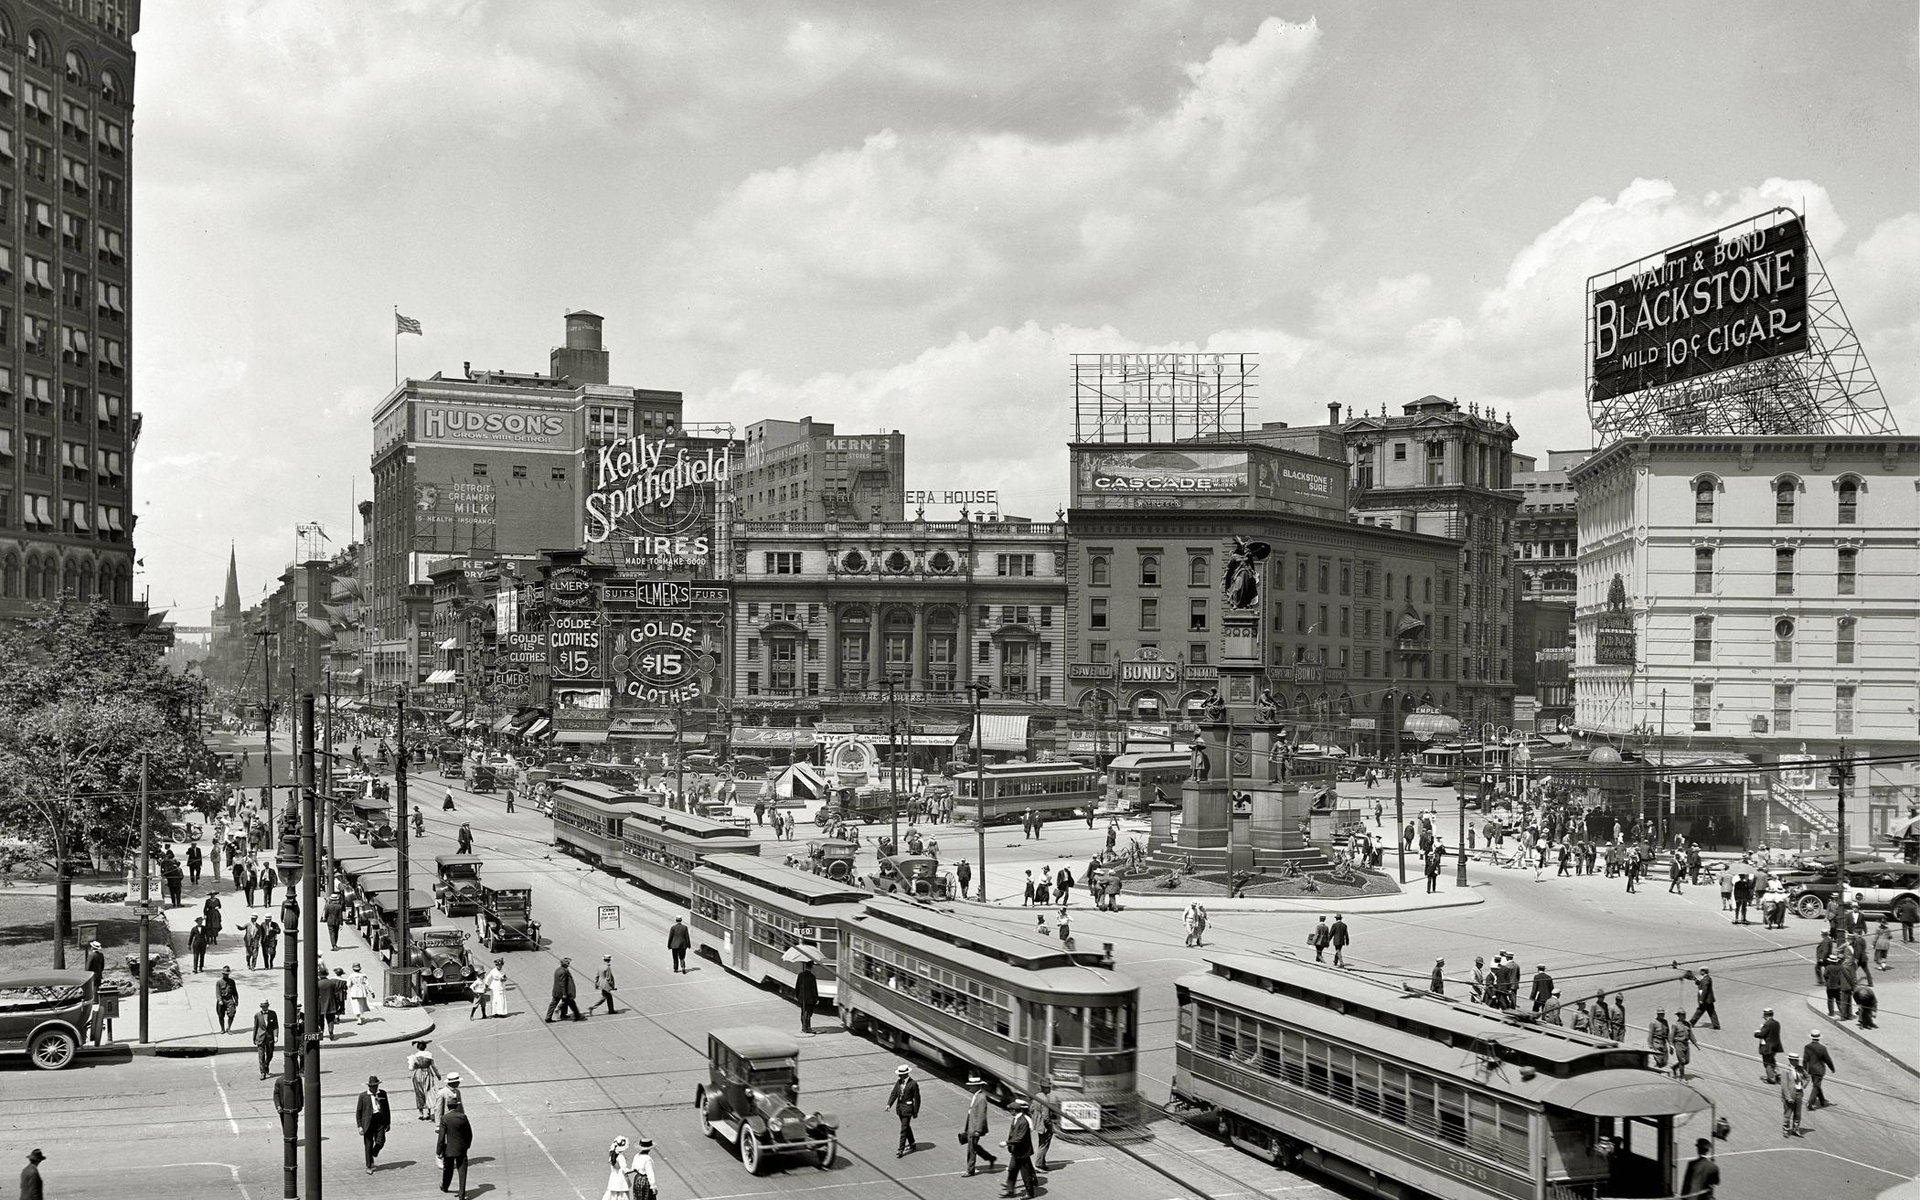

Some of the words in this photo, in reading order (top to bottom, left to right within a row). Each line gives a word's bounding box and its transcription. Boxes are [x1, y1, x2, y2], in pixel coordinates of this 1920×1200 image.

[1631, 256, 1688, 293] WAITT
[1692, 250, 1704, 271] &
[1713, 228, 1766, 267] BOND
[1595, 249, 1796, 360] BLACKSTONE
[1622, 346, 1659, 370] MILD
[1707, 308, 1802, 356] CIGAR
[1123, 383, 1213, 404] FLOUR
[425, 409, 564, 437] HUDSON'S
[453, 432, 489, 440] GROWS
[514, 435, 552, 444] DETROIT
[826, 439, 890, 450] KERN'S
[1095, 477, 1212, 488] CASCADE
[1282, 469, 1328, 485] BLACKSTONE
[453, 484, 490, 492] DETROIT
[584, 447, 729, 543] Springfield
[1308, 482, 1328, 493] SURE
[448, 492, 496, 502] CREAMERY
[944, 491, 997, 503] HOUSE
[454, 502, 488, 514] MILK
[629, 536, 709, 555] TIRES
[662, 557, 683, 566] MAKE
[686, 558, 706, 566] GOOD
[550, 581, 590, 591] ELMER'S
[605, 590, 635, 598] SUITS
[638, 582, 689, 607] ELMER'S
[695, 590, 724, 599] FURS
[556, 619, 592, 629] GOLDE
[630, 621, 697, 643] GOLDE
[510, 634, 546, 645] GOLDE
[551, 632, 599, 649] CLOTHES
[510, 652, 546, 661] CLOTHES
[560, 651, 589, 671] $15
[642, 654, 682, 675] $15
[1123, 663, 1176, 680] BOND'S
[627, 681, 701, 707] CLOTHES
[304, 1033, 319, 1041] FORT
[1448, 1157, 1487, 1180] 7126
